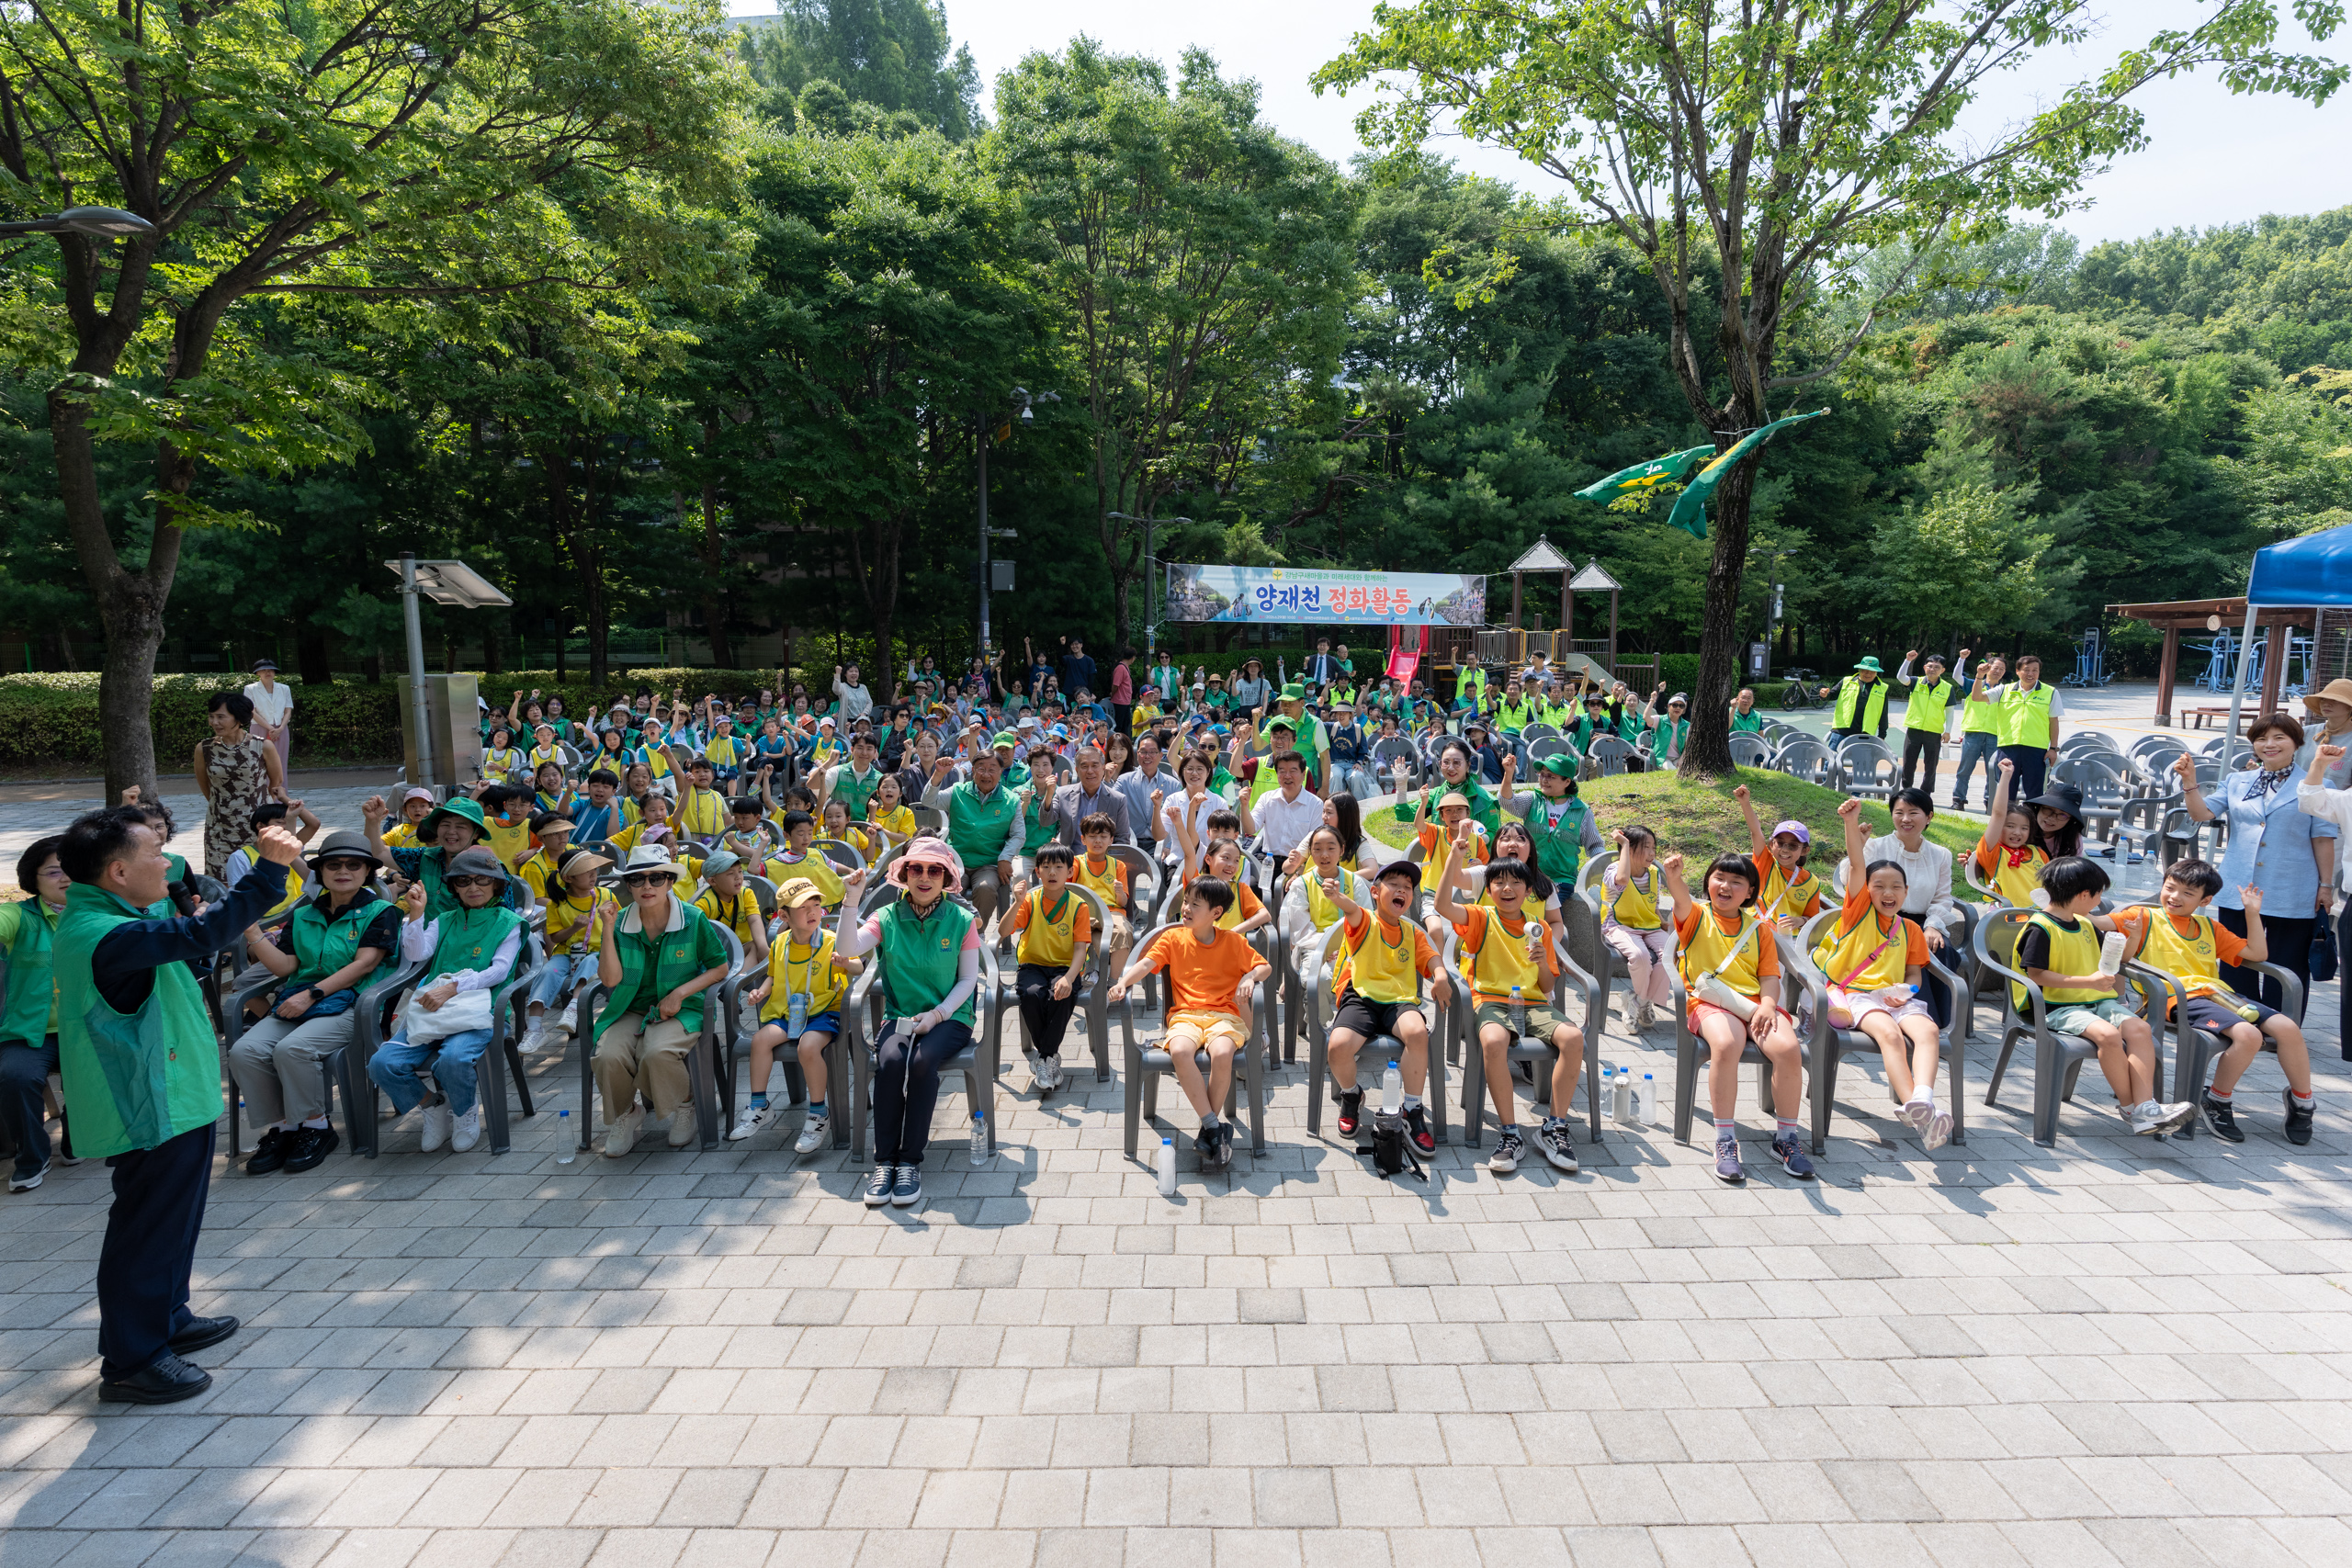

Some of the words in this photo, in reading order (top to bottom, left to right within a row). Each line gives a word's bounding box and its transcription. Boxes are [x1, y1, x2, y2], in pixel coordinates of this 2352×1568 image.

[1285, 571, 1329, 580] 강남구새마을과
[1255, 582, 1321, 613] 양재천
[1328, 585, 1412, 615] 정화활동
[752, 1115, 762, 1123] N
[815, 1123, 825, 1132] N
